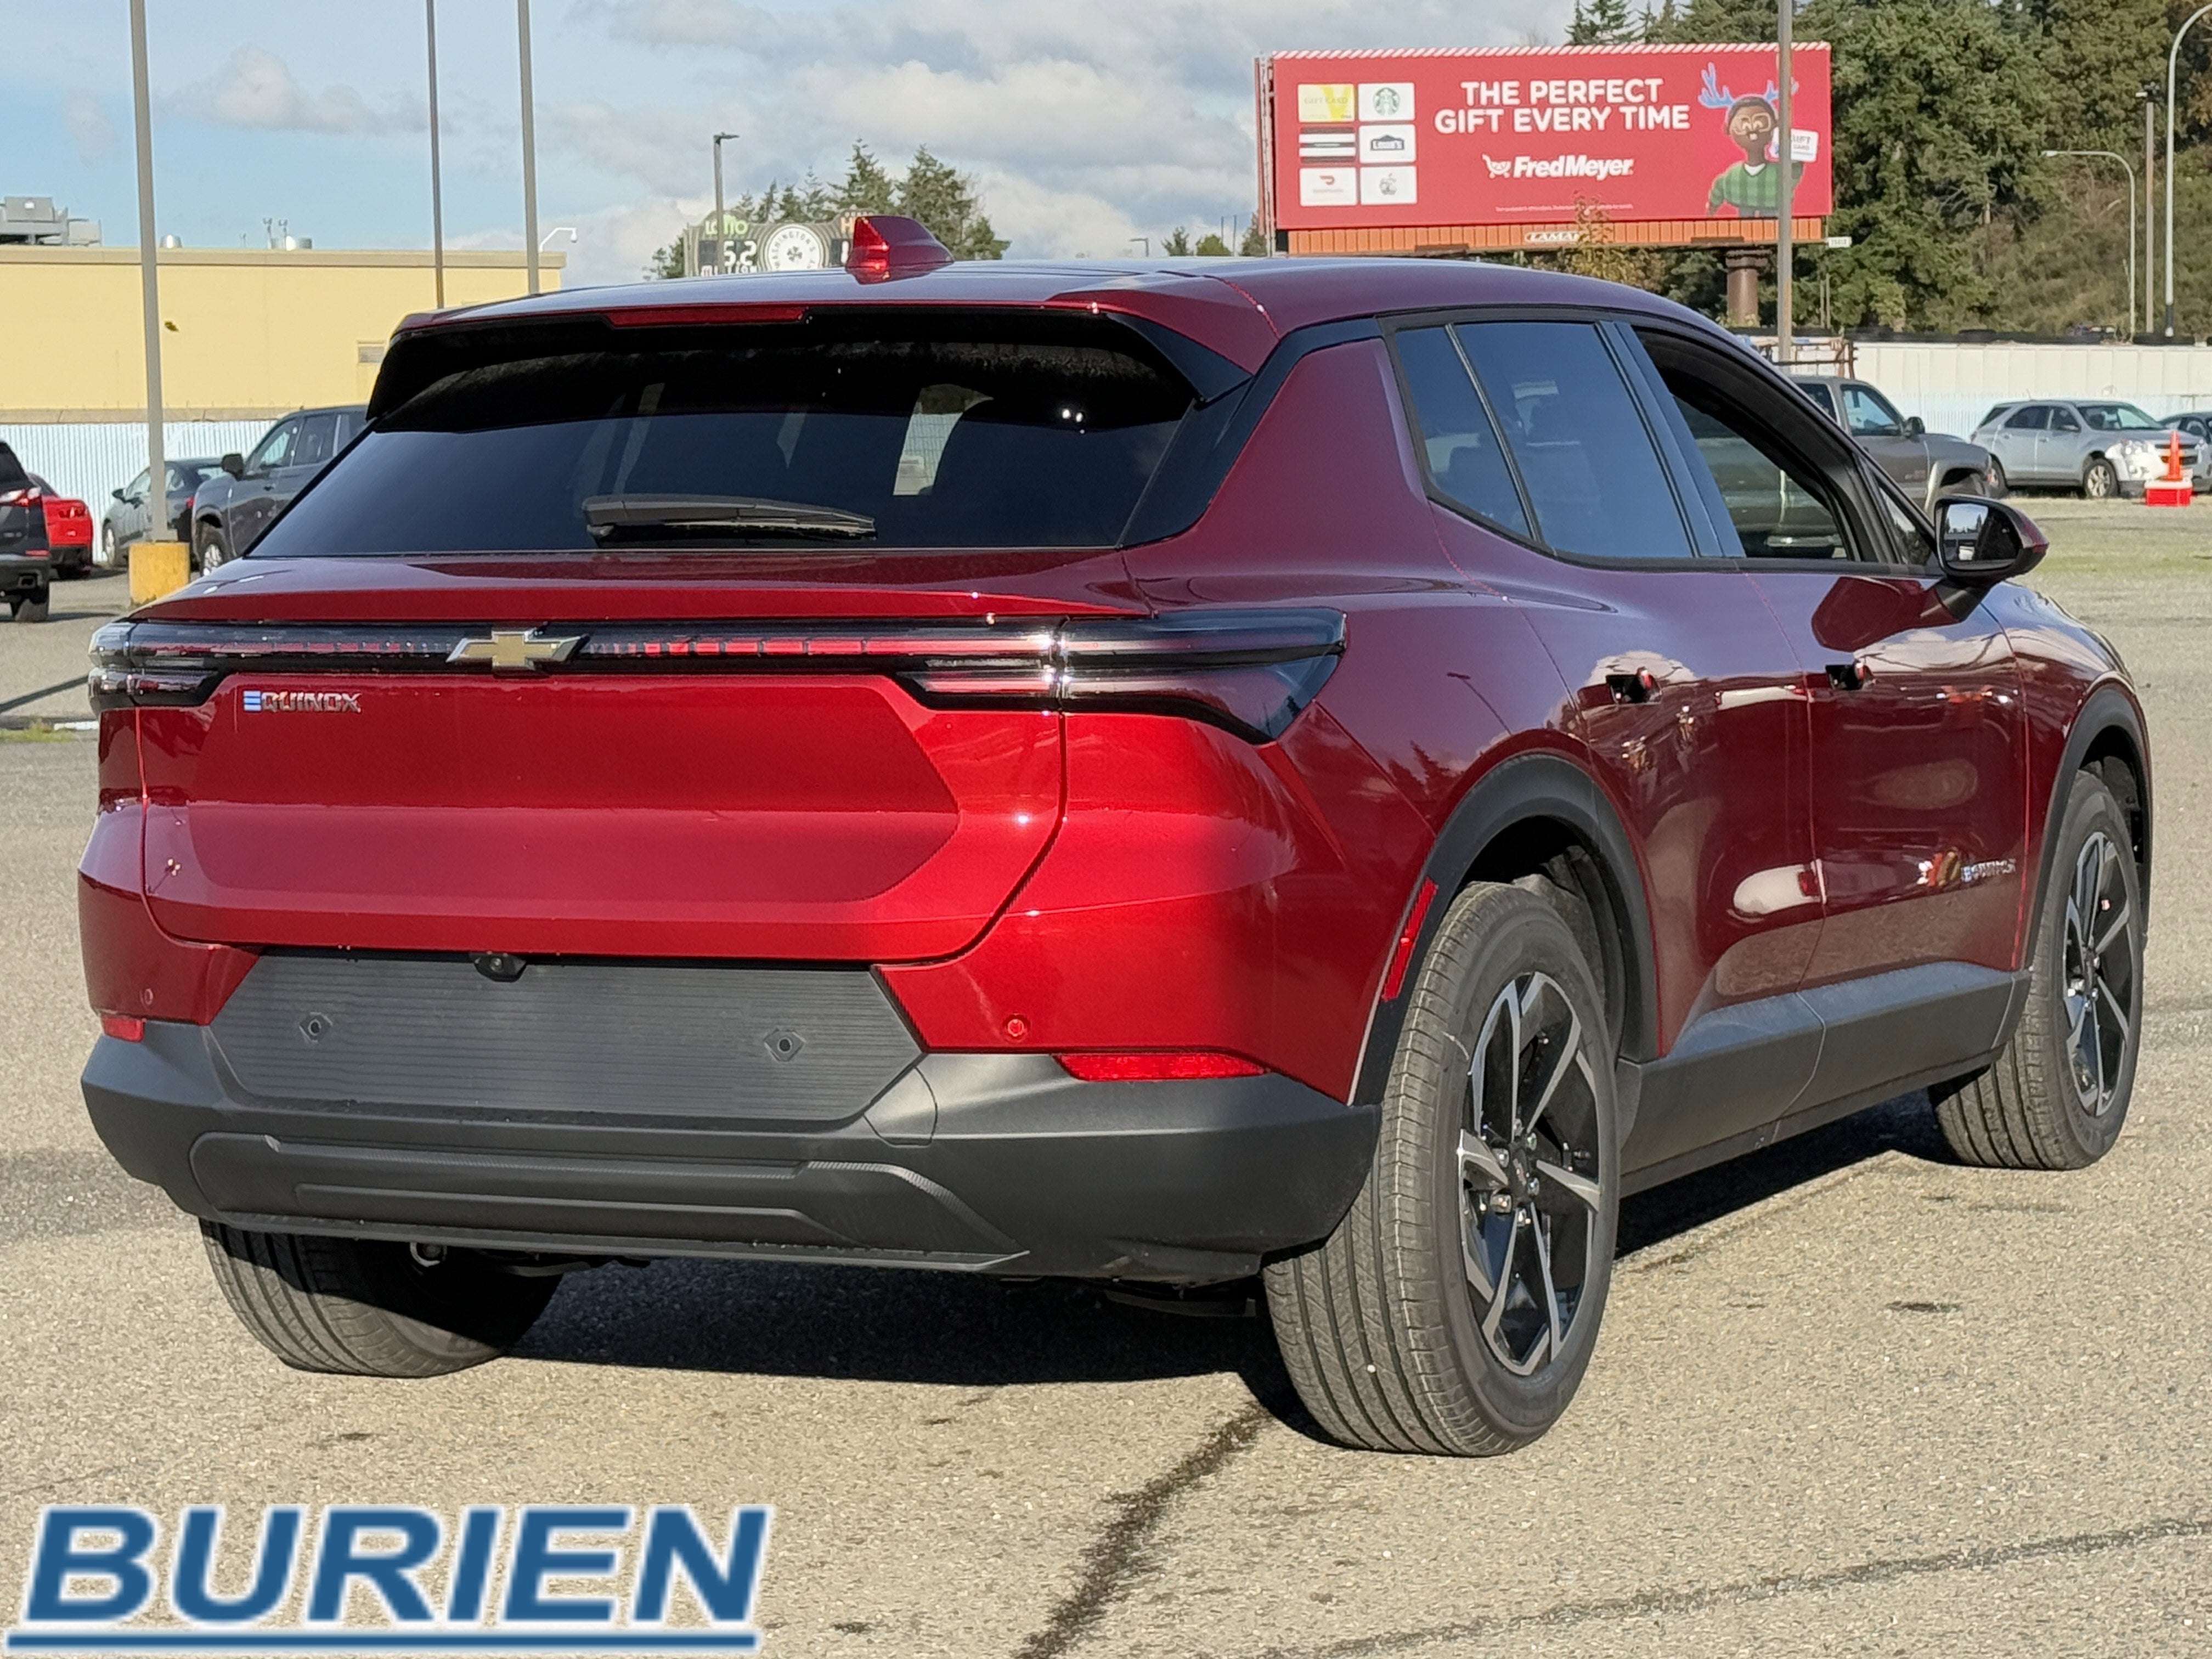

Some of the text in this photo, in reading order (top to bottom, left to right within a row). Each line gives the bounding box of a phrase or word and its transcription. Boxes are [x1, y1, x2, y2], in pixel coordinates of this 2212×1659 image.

[1460, 78, 1664, 106] THE PERFECT
[1434, 105, 1690, 134] GIFT EVERY TIME
[243, 690, 362, 713] EQUINOX
